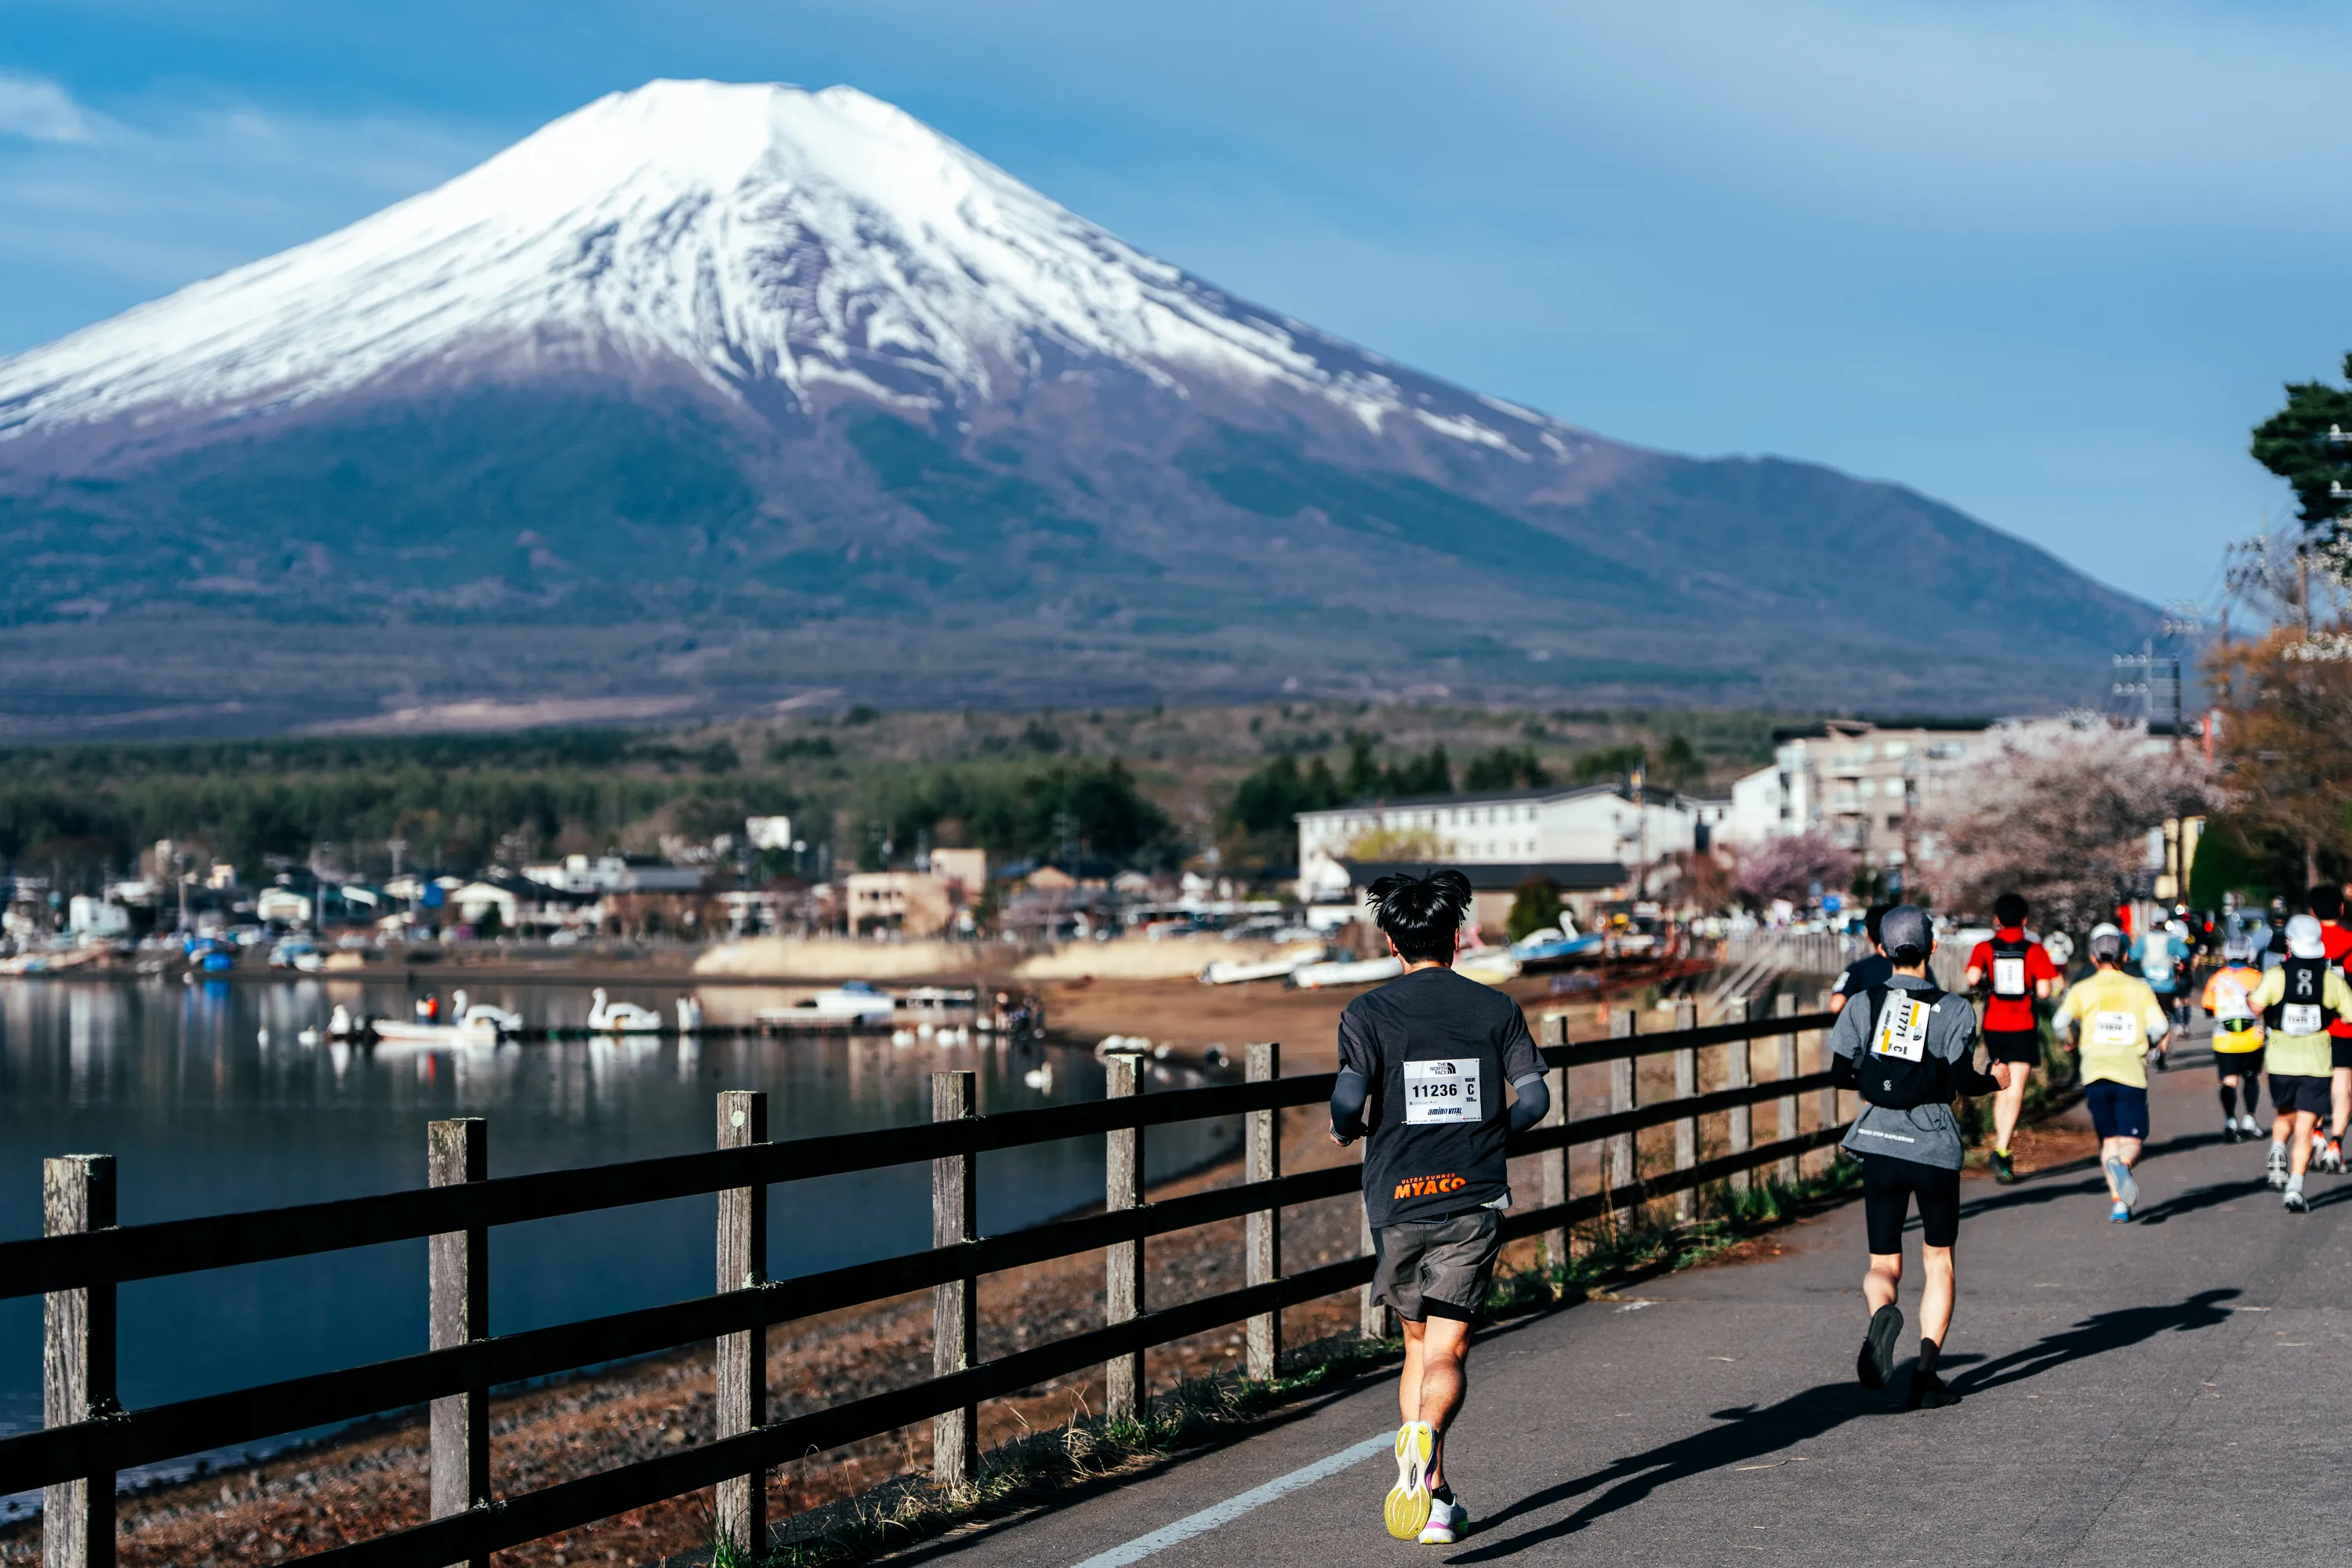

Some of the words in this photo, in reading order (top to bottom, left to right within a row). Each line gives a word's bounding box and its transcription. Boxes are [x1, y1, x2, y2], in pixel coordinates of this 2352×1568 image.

[1896, 1004, 1911, 1037] 11771
[1412, 1083, 1457, 1098] 11236
[1467, 1083, 1475, 1095] C
[1428, 1106, 1448, 1116] amino
[1884, 1133, 1915, 1143] EXPLORING
[1394, 1178, 1466, 1200] MYACO
